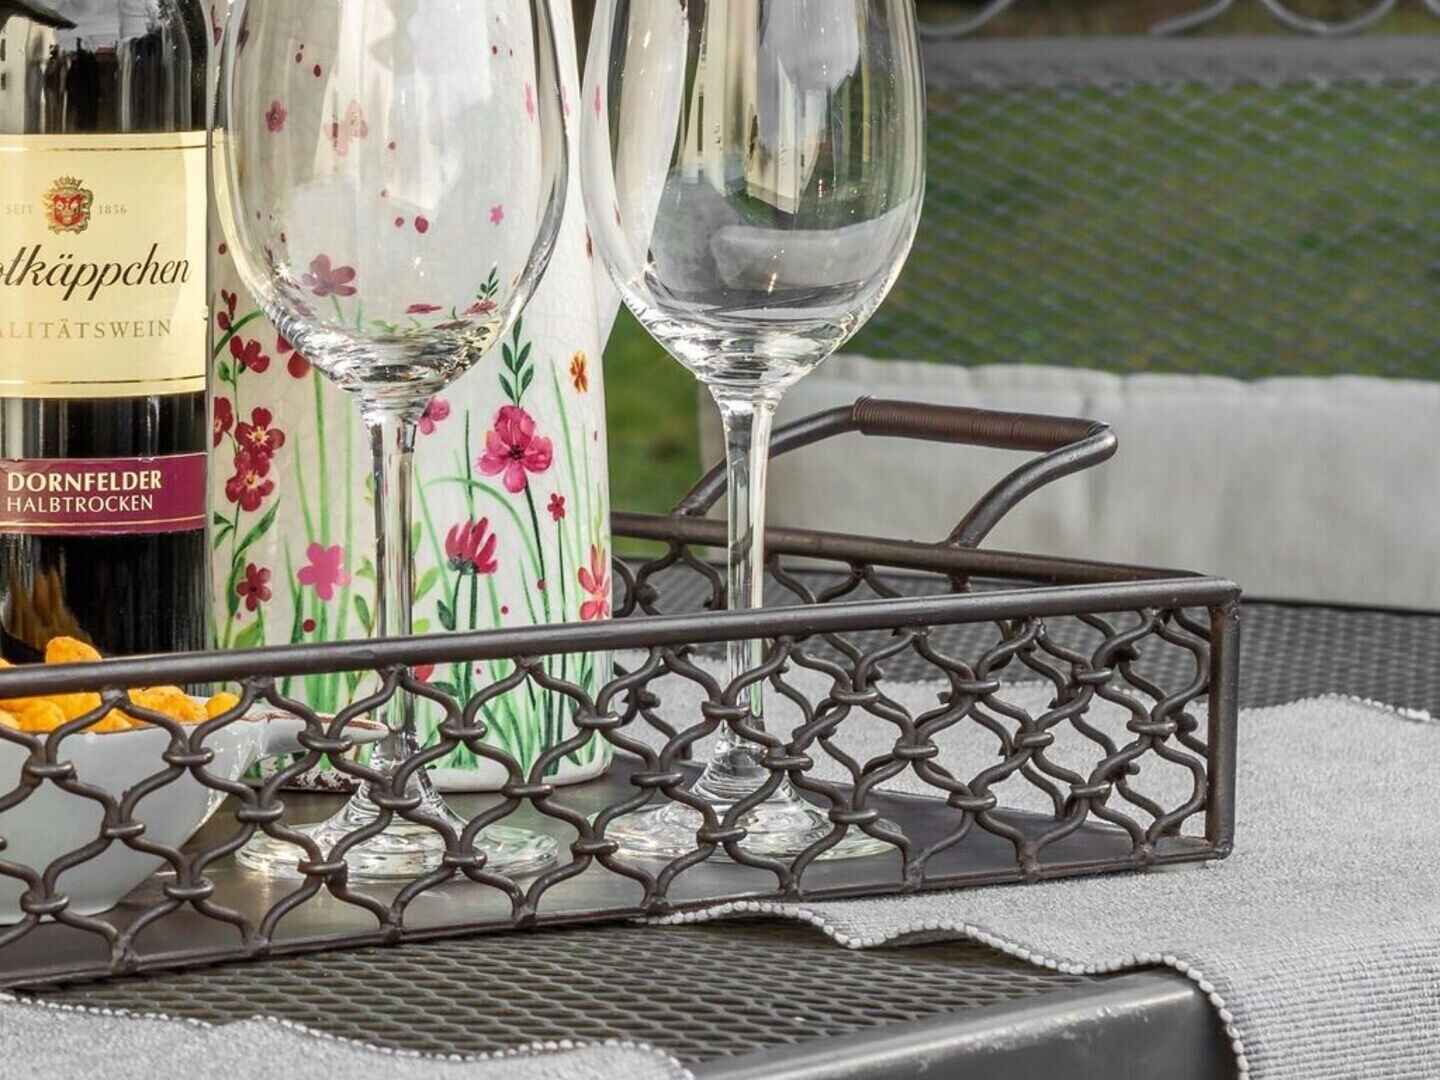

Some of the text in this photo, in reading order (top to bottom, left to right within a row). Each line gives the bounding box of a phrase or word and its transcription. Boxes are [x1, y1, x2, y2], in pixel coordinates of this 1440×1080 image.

[5, 204, 127, 215] SEIT 1856
[7, 470, 162, 492] DORNFELDER
[6, 494, 154, 513] HALBTROCKEN
